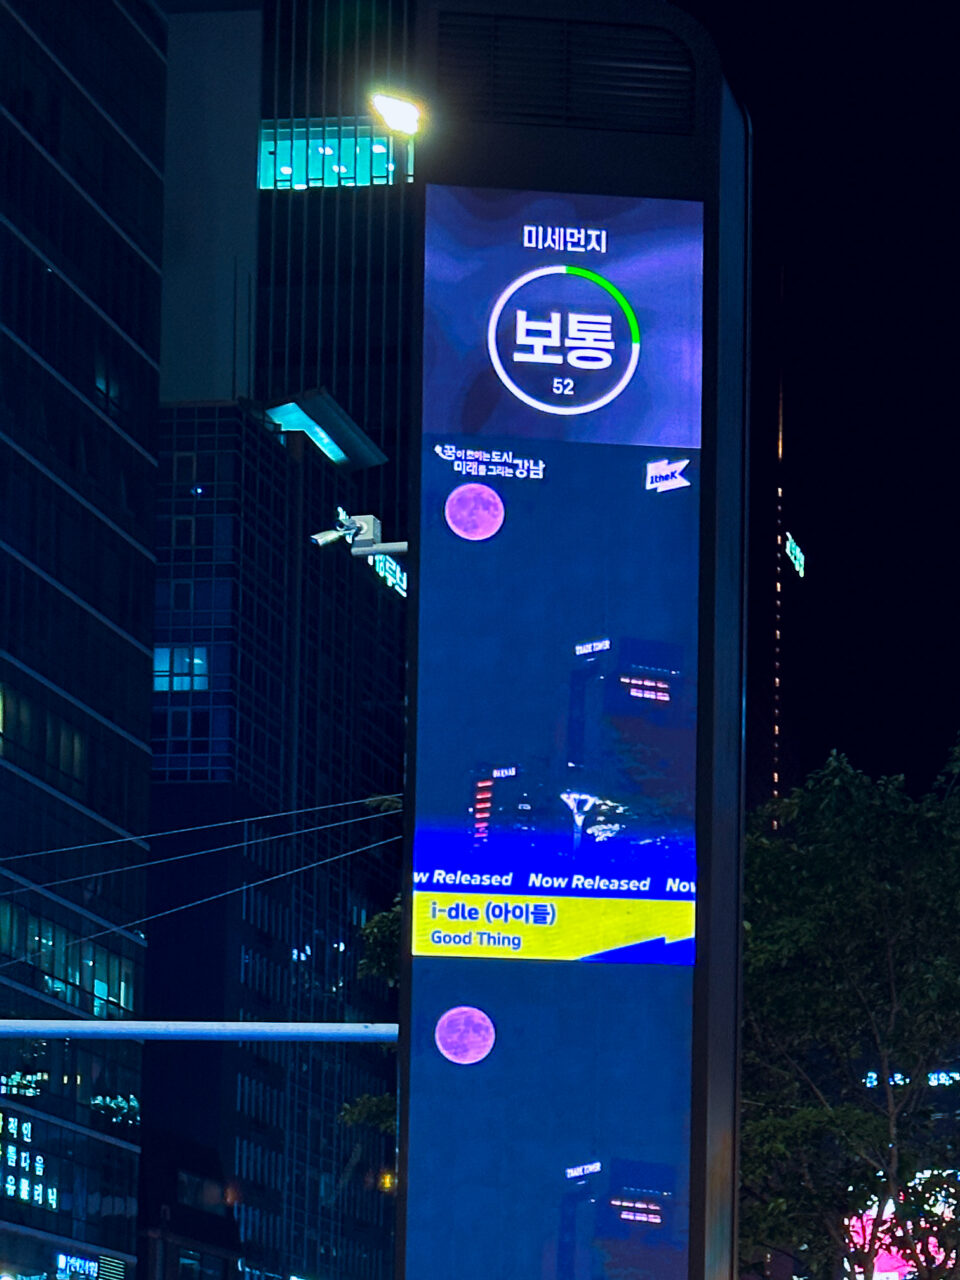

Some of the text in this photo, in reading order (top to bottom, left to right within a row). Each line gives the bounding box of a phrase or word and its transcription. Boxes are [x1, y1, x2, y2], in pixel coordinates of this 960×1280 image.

[523, 224, 607, 254] 미세먼지
[513, 309, 615, 370] 보통
[552, 378, 574, 395] 52
[491, 451, 513, 463] 도시
[513, 459, 546, 479] 강남
[433, 869, 513, 887] Released
[528, 872, 568, 888] Now
[571, 874, 650, 892] Released
[431, 901, 557, 925] i-dle (아이들)
[431, 930, 522, 950] Good Thing
